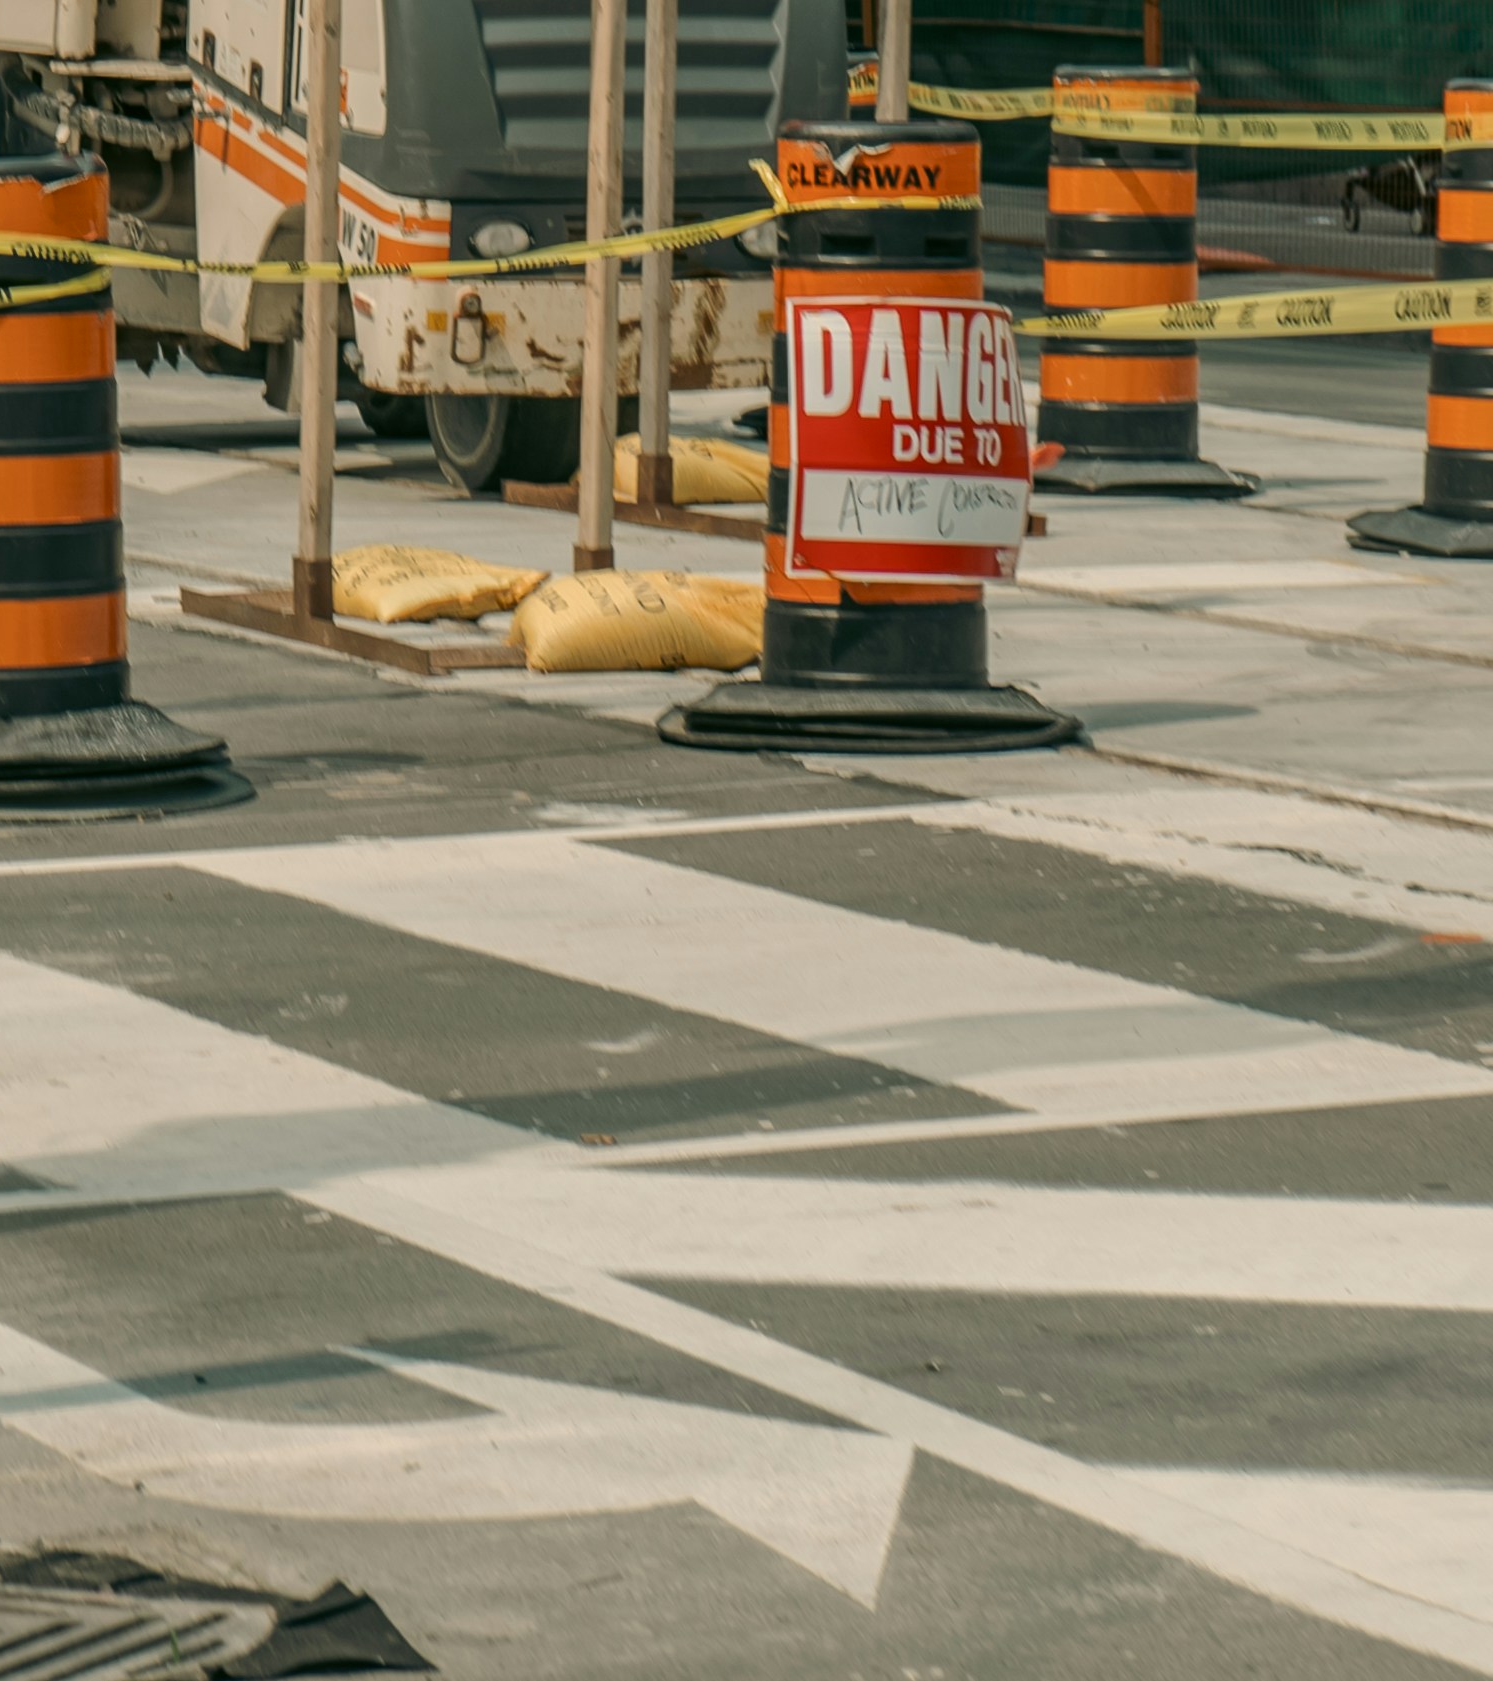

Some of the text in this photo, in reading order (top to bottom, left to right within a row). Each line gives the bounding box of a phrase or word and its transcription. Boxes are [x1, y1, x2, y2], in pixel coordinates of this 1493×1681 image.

[786, 162, 942, 190] CLEARWAY
[1275, 296, 1335, 328] CAUTION
[1394, 288, 1452, 321] CAUTION
[892, 424, 1002, 468] DUE TO
[838, 476, 930, 535] ACTIVE
